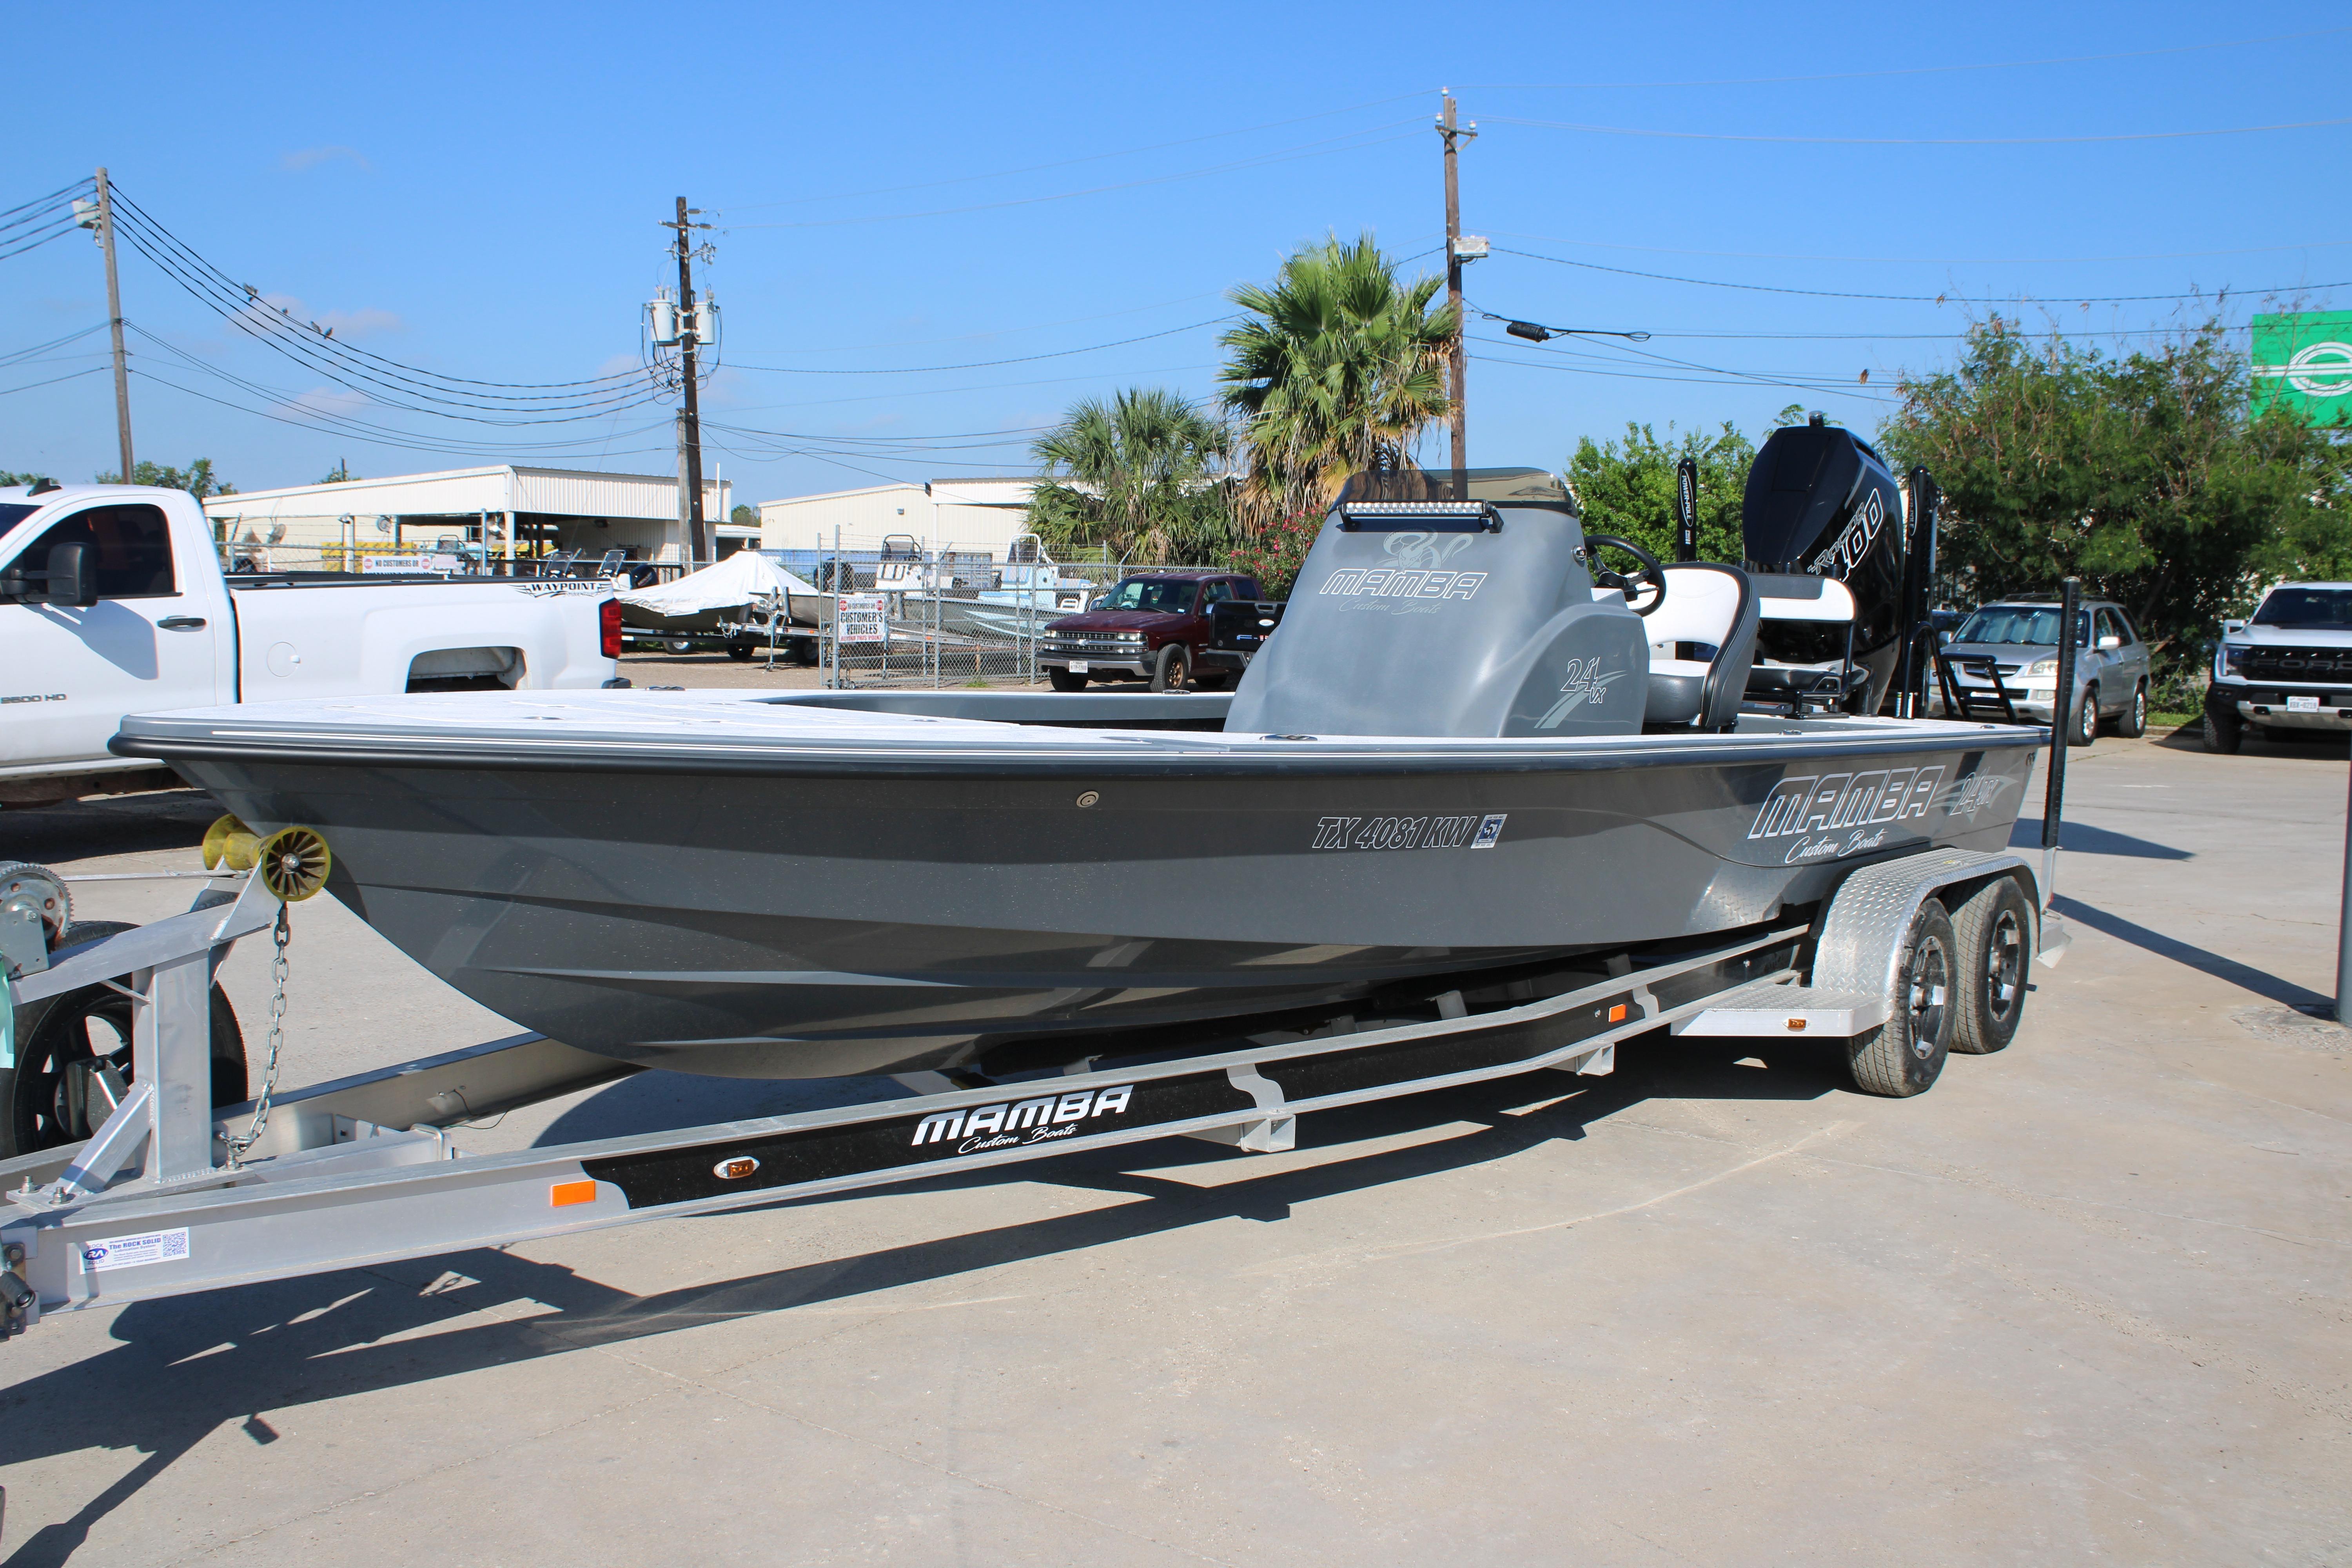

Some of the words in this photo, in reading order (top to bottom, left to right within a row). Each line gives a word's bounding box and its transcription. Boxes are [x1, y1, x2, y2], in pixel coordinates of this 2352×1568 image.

[1681, 475, 1692, 520] POWER-POLE
[1808, 502, 1865, 575] Racing
[531, 583, 596, 591] WAYPOINT
[1318, 568, 1488, 600] MAMBA
[840, 612, 883, 623] CUSTOMER'S
[1339, 597, 1391, 612] Custom
[1391, 599, 1442, 615] Boats
[847, 624, 878, 635] VEHICLES
[1560, 656, 1600, 692] 24
[1589, 687, 1606, 704] VX
[1747, 765, 1946, 840] MAMBA
[1312, 817, 1362, 848] TX
[1355, 817, 1428, 849] 4081
[1421, 816, 1477, 848] KW
[1785, 836, 1839, 864] Custom
[1838, 828, 1888, 857] Boats
[911, 1085, 1134, 1146] MAMBA
[958, 1134, 1020, 1154] Custom
[1022, 1123, 1078, 1145] Boats
[87, 1250, 104, 1258] RA
